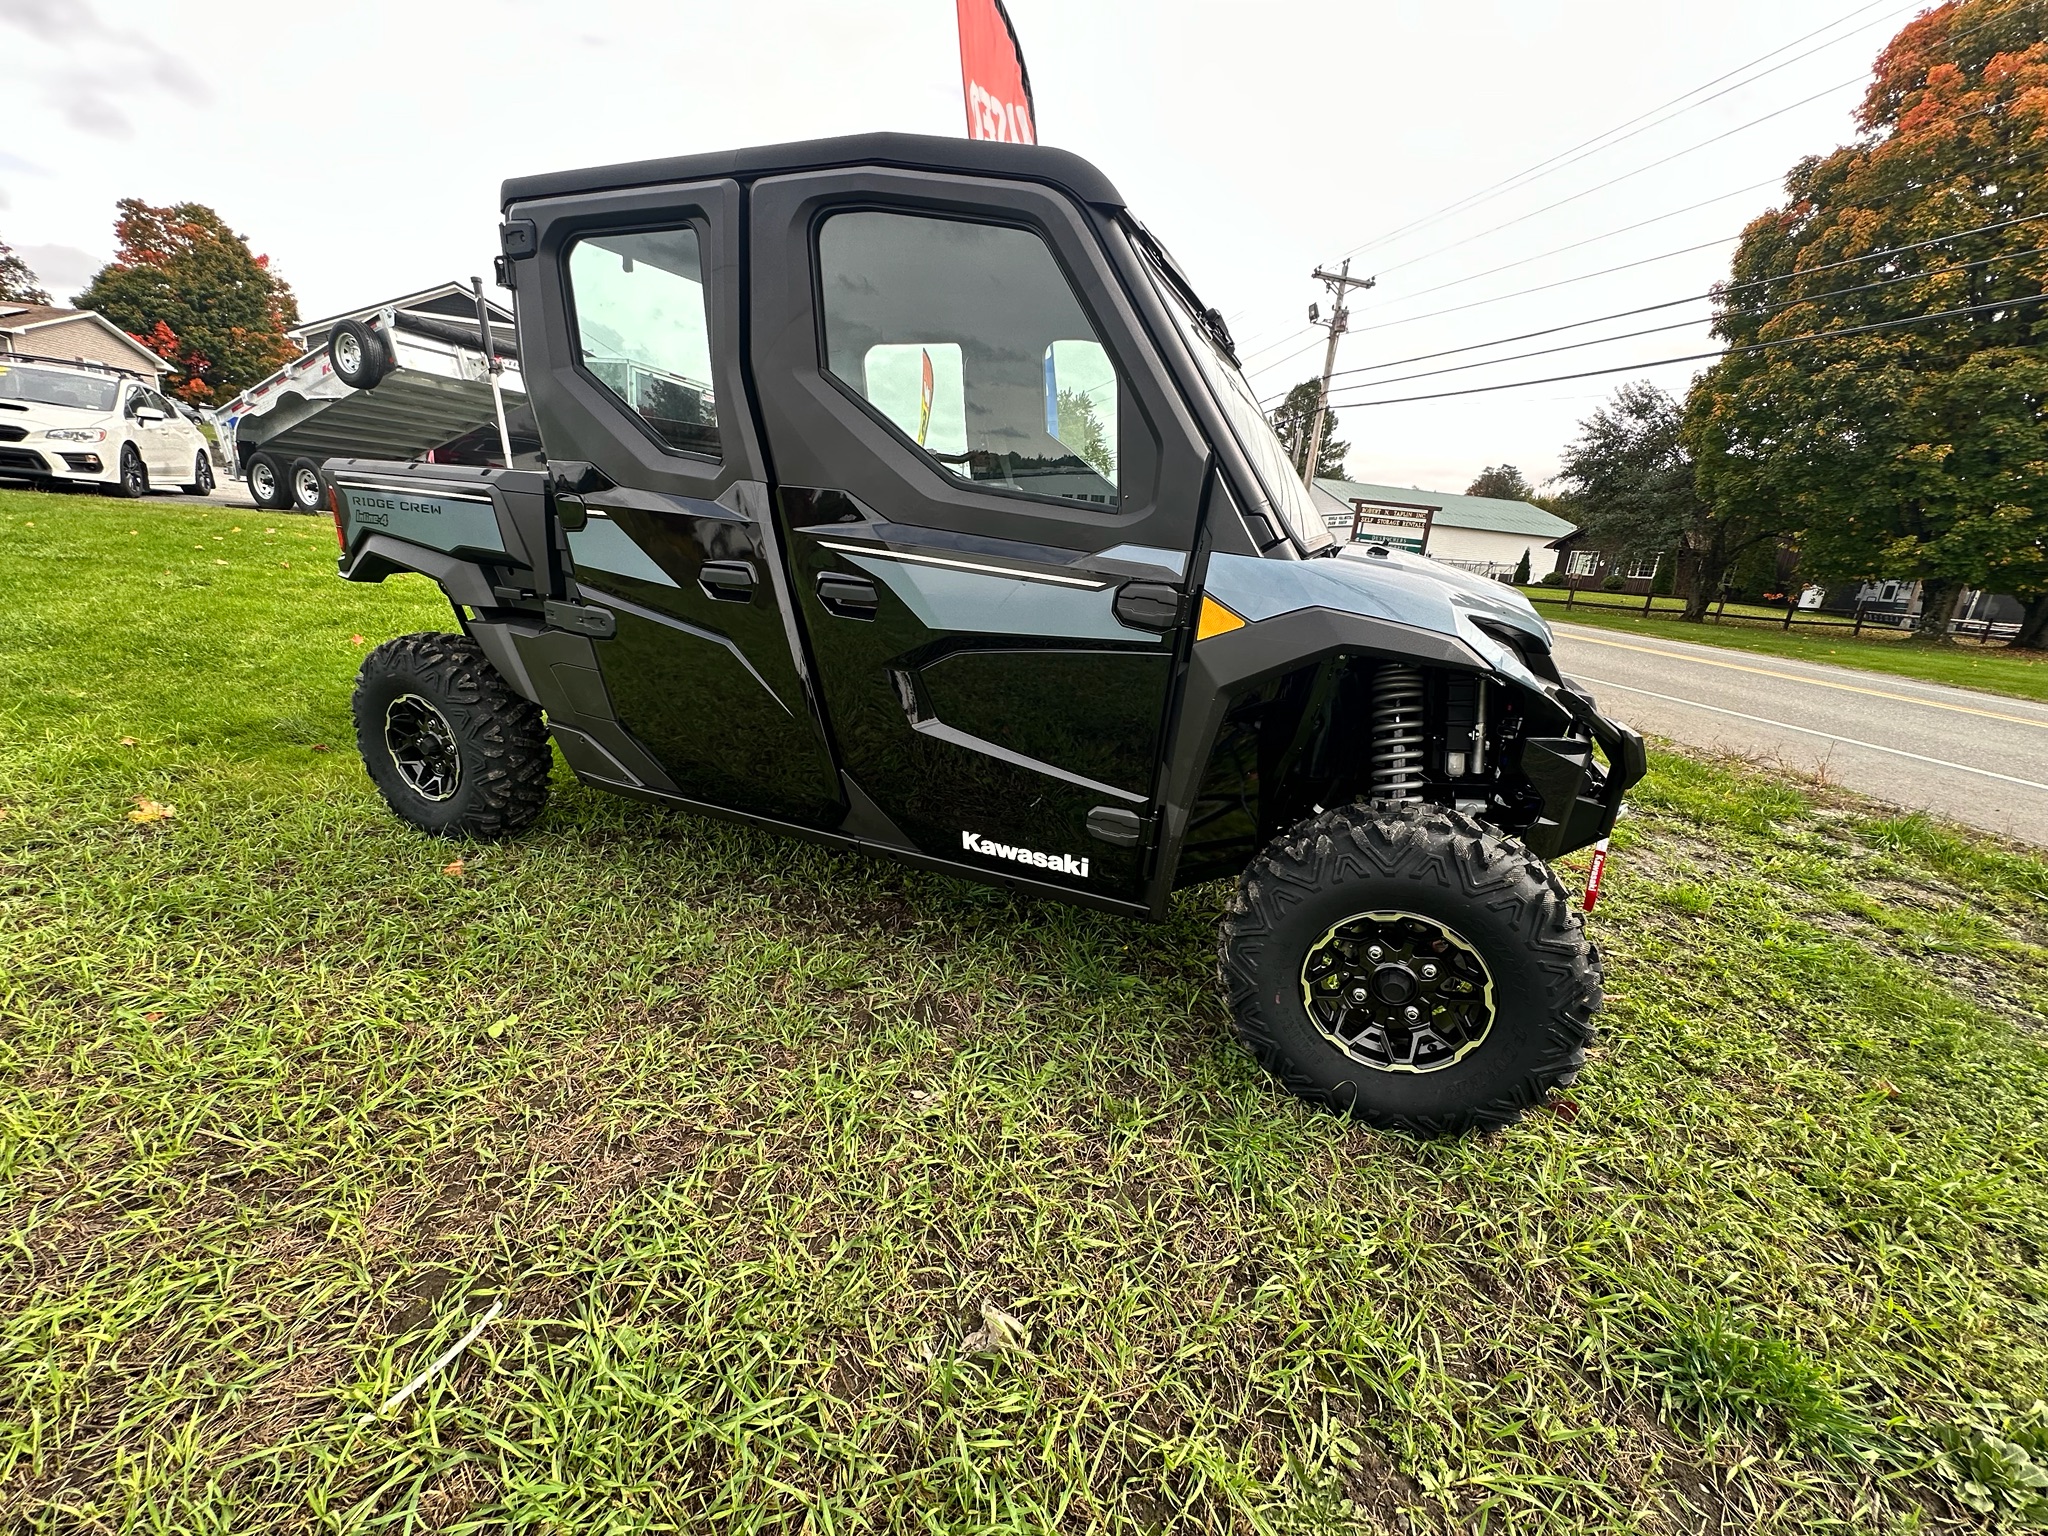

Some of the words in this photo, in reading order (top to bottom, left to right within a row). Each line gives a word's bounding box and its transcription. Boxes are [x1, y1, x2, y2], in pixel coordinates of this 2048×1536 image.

[352, 496, 395, 510] RIDGE
[400, 501, 442, 515] CREW
[1376, 518, 1400, 526] STORAGE
[962, 830, 1089, 878] Kawasaki
[1587, 854, 1604, 892] Kawasaki
